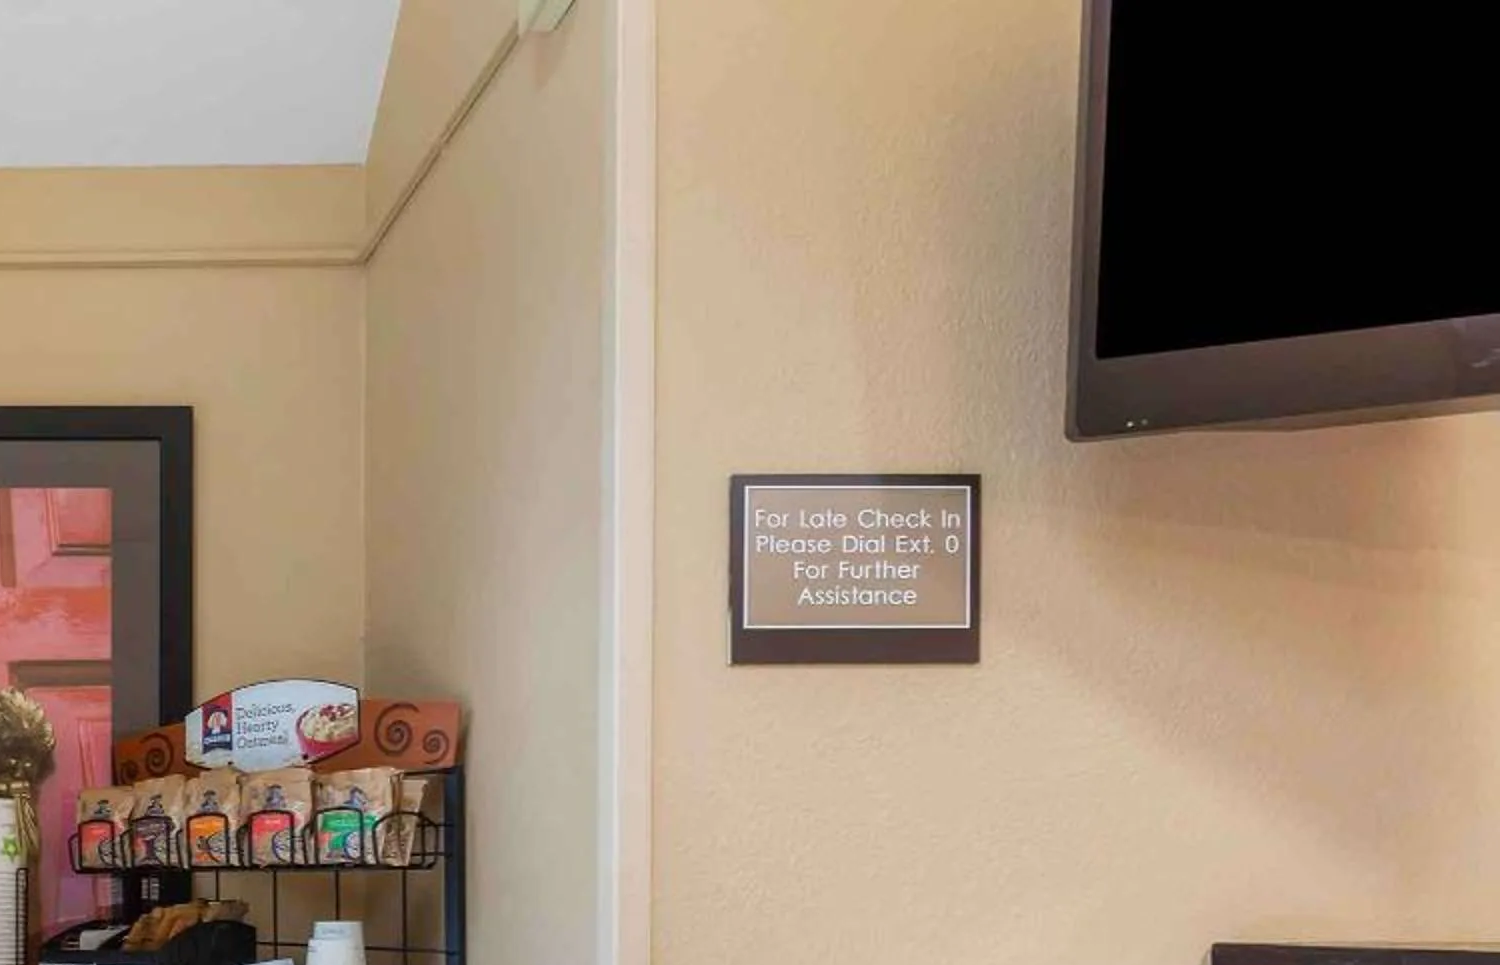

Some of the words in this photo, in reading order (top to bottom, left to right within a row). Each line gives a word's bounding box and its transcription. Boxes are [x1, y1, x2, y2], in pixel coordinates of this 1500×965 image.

[754, 508, 790, 529] For
[799, 508, 848, 529] Late
[857, 507, 933, 529] Check
[940, 508, 962, 529] In
[755, 535, 833, 554] Please
[842, 534, 886, 554] Dial
[894, 534, 935, 554] Ext.
[793, 560, 830, 580] For
[838, 560, 921, 580] Further
[797, 585, 918, 606] Assistance
